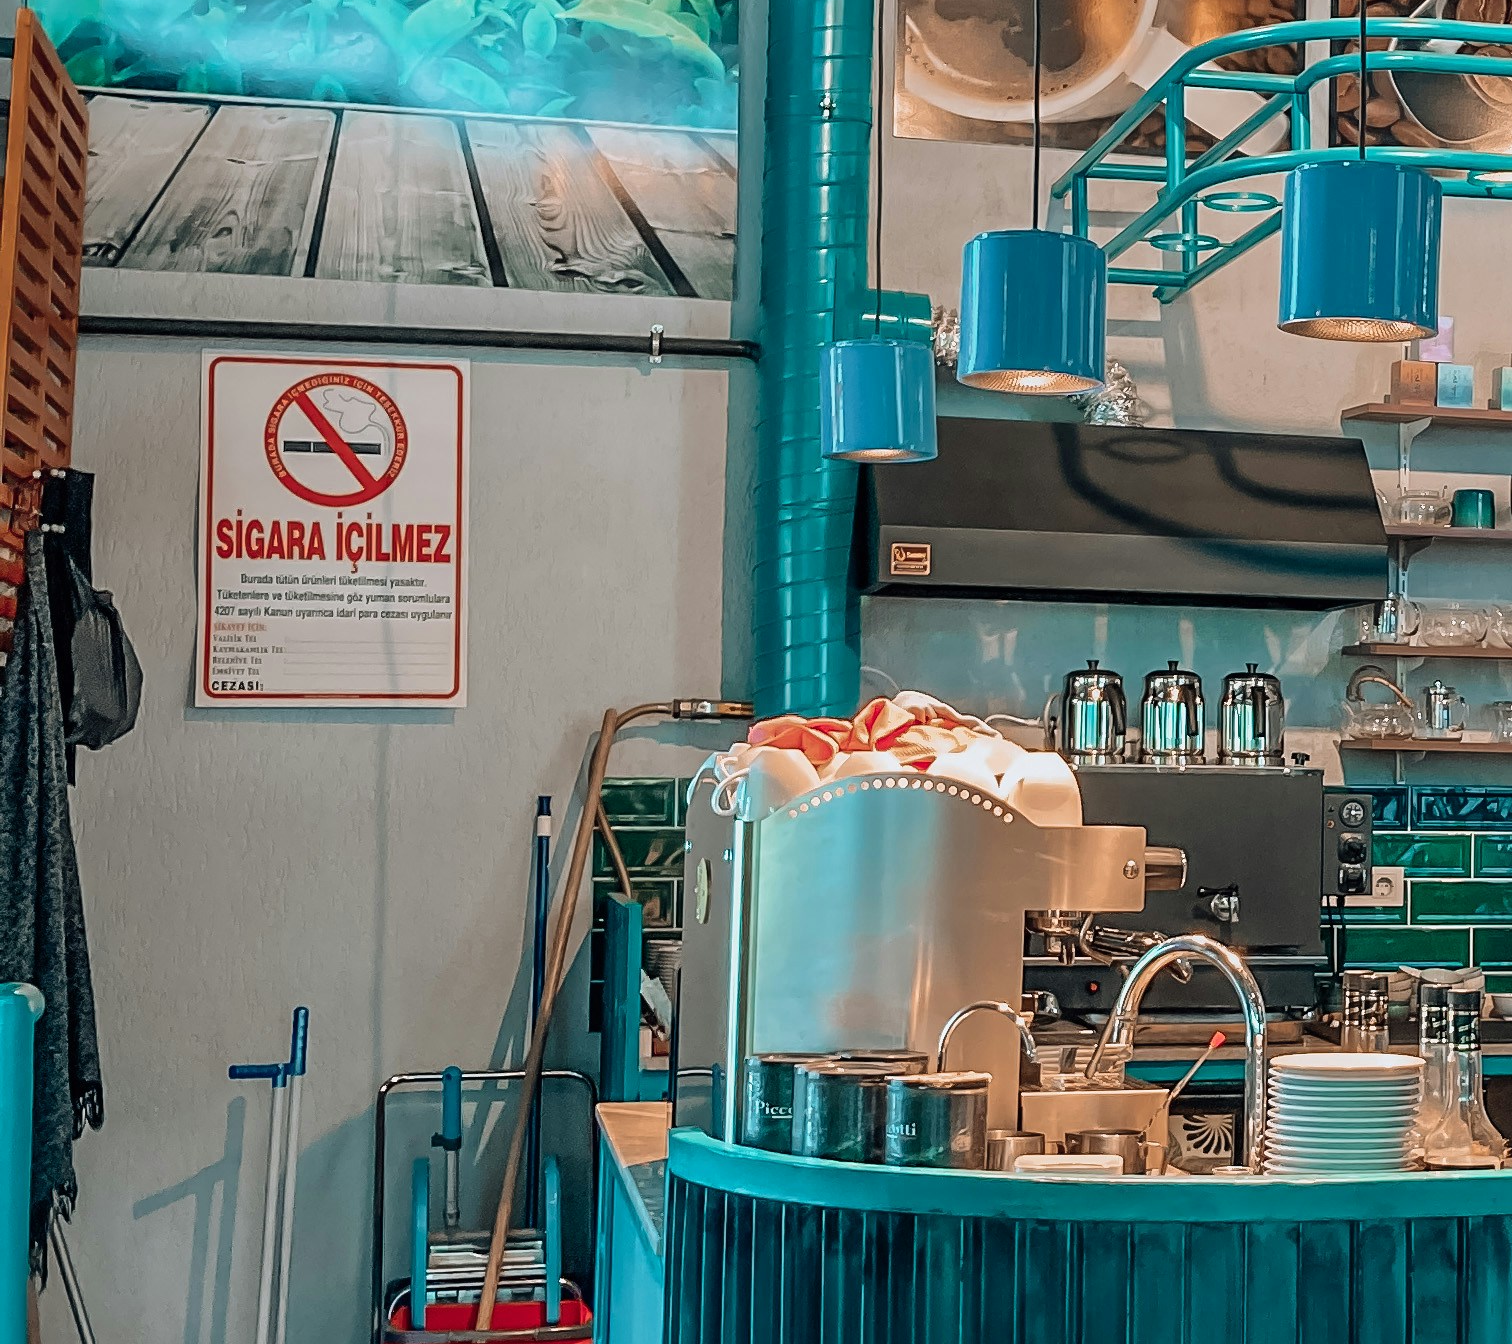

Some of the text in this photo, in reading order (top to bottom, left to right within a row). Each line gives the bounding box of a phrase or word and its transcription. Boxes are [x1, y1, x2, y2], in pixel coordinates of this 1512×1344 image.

[215, 509, 451, 574] SİGARA İÇİLMEZ
[240, 573, 273, 584] Burada
[275, 574, 299, 585] tütün
[272, 592, 282, 601] ve
[347, 593, 363, 605] göz
[365, 594, 395, 605] yuman
[214, 605, 235, 616] 4207
[264, 606, 292, 617] Kanun
[358, 610, 378, 621] para
